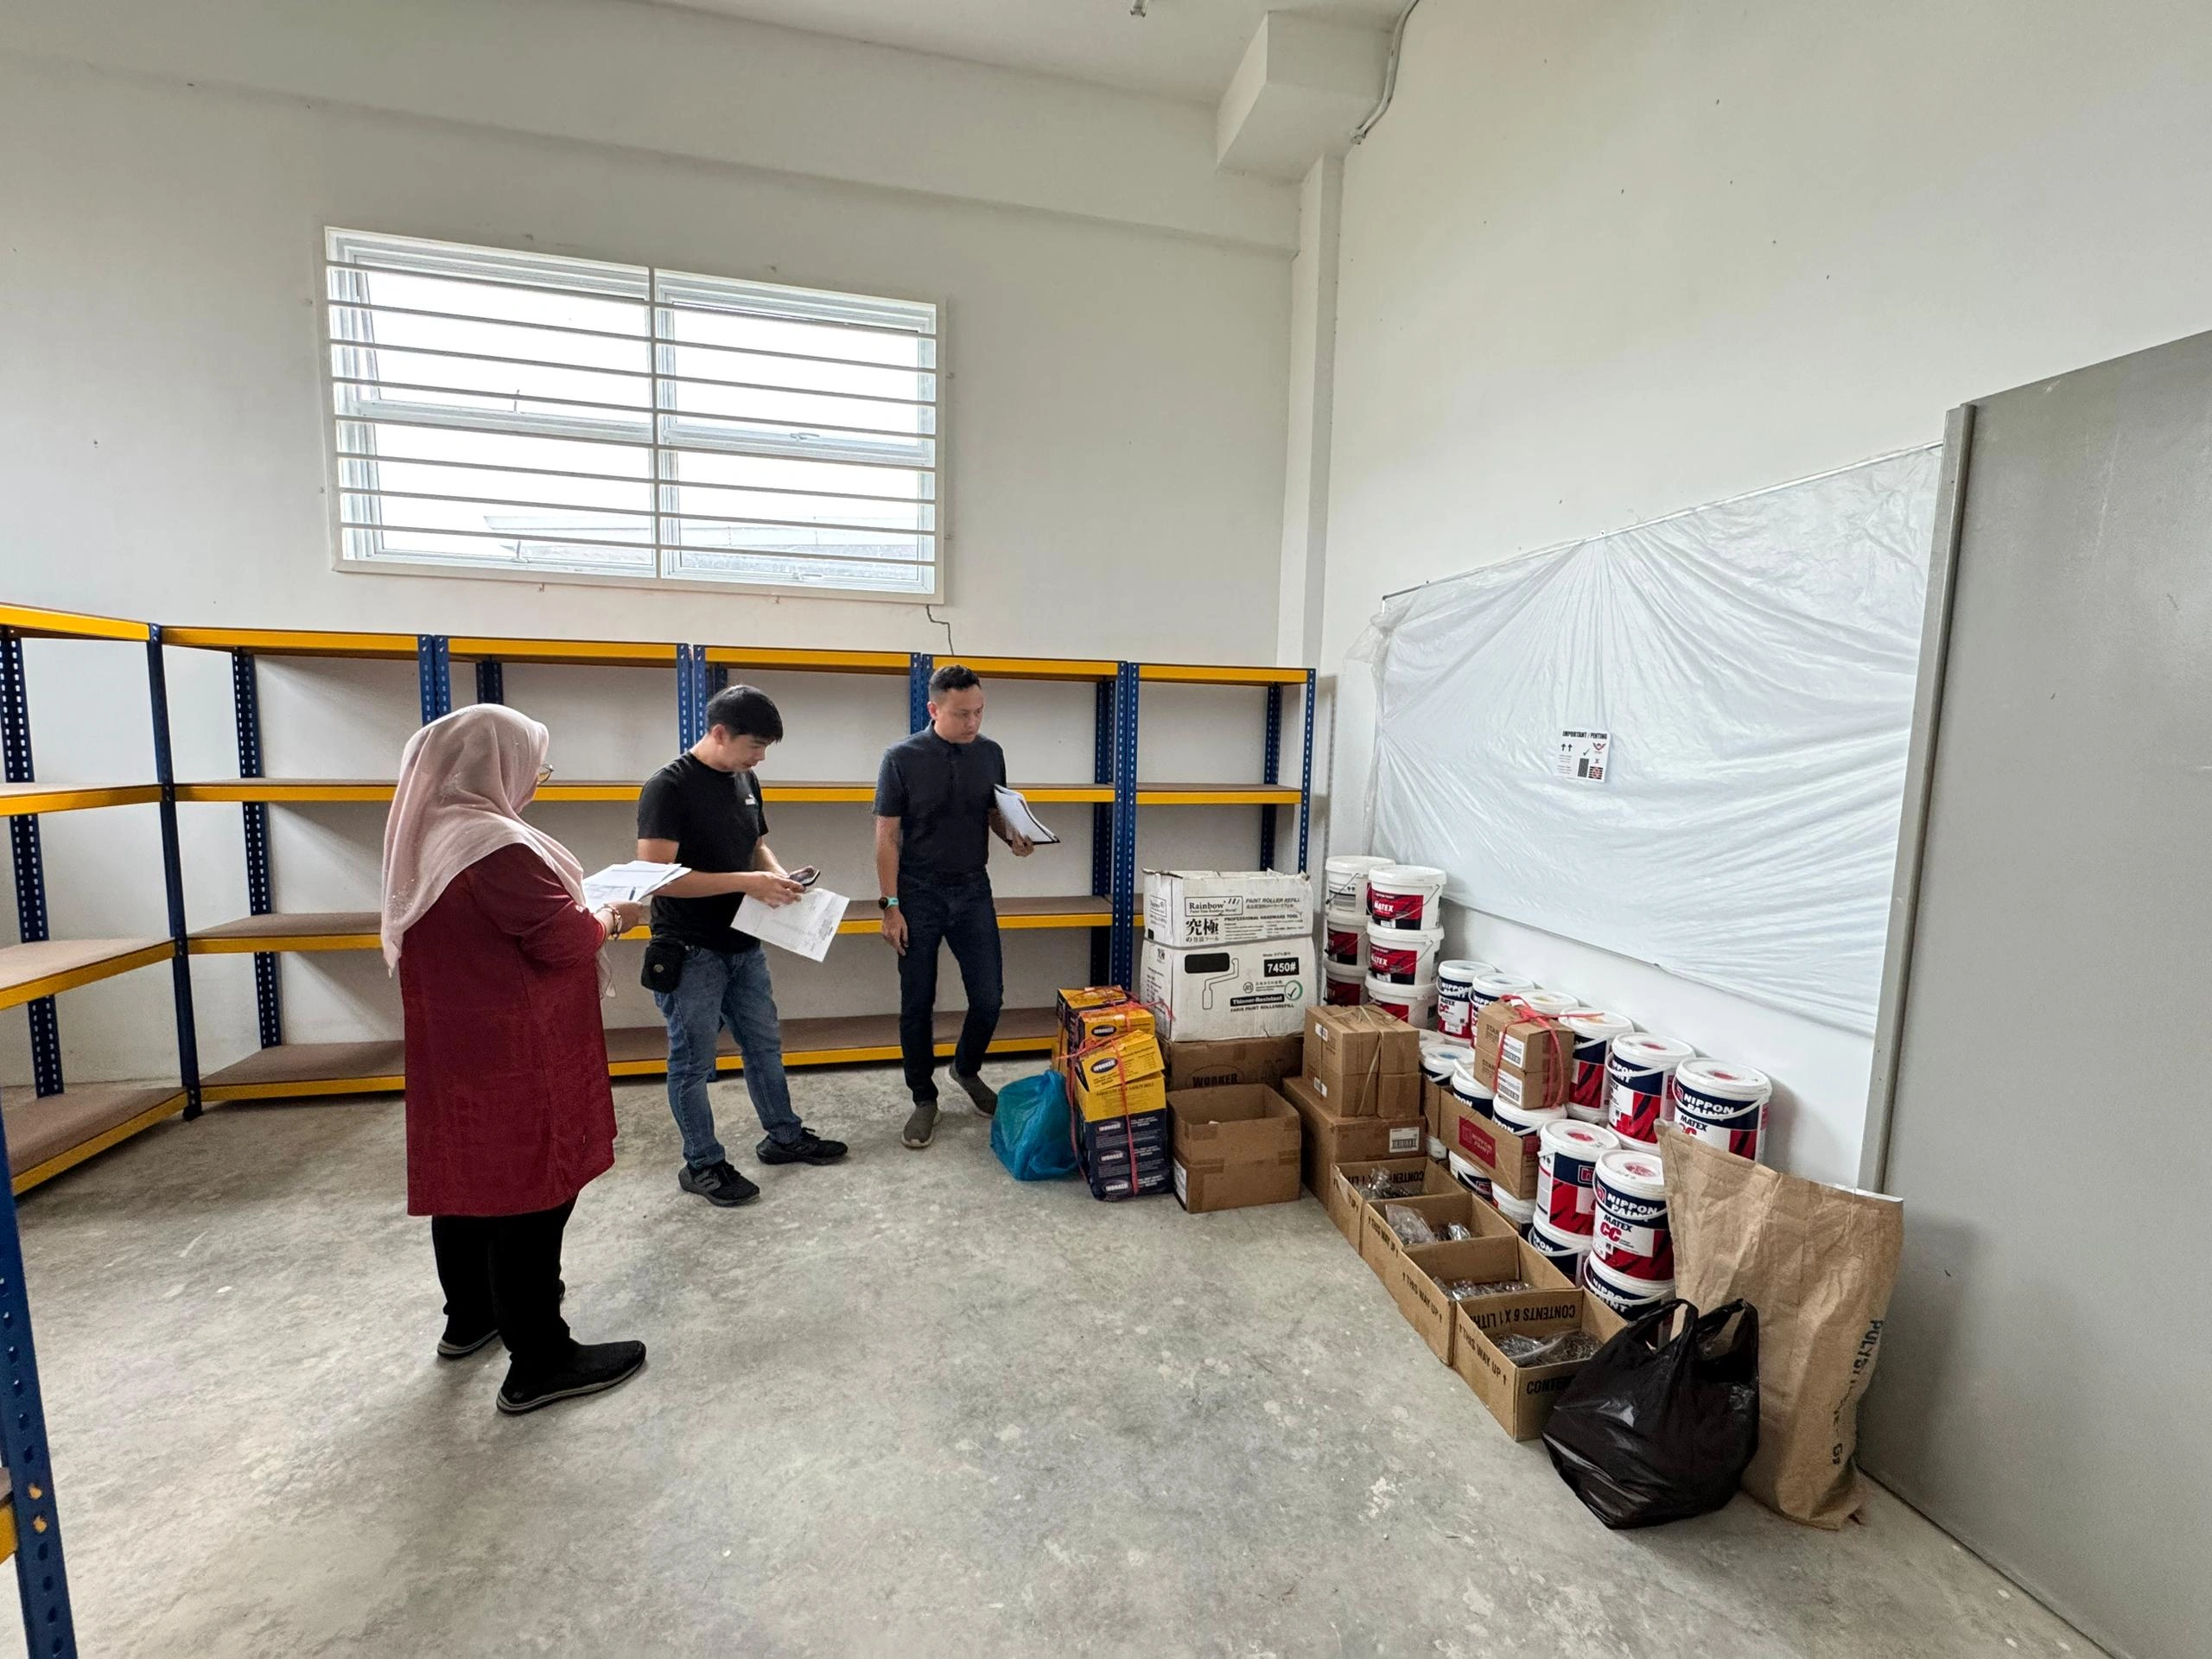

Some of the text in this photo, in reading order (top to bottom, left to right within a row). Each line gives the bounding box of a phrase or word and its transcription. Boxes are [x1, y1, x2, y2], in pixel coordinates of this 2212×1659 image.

[1189, 901, 1224, 910] Rainbow
[1185, 918, 1219, 937] 究極
[1267, 961, 1296, 974] 7450#
[1192, 1073, 1237, 1088] WORKER
[1683, 1093, 1735, 1115] NIPPON
[1680, 1115, 1708, 1132] MATEX
[1607, 1193, 1657, 1215] NIPPON
[1600, 1221, 1622, 1242] CC
[1604, 1215, 1633, 1233] MATEX
[1407, 1274, 1439, 1317] THIS WAY UP
[1513, 1308, 1521, 1322] 6
[1523, 1305, 1575, 1322] CONTENTS
[1463, 1326, 1501, 1377] THIS WAY UP
